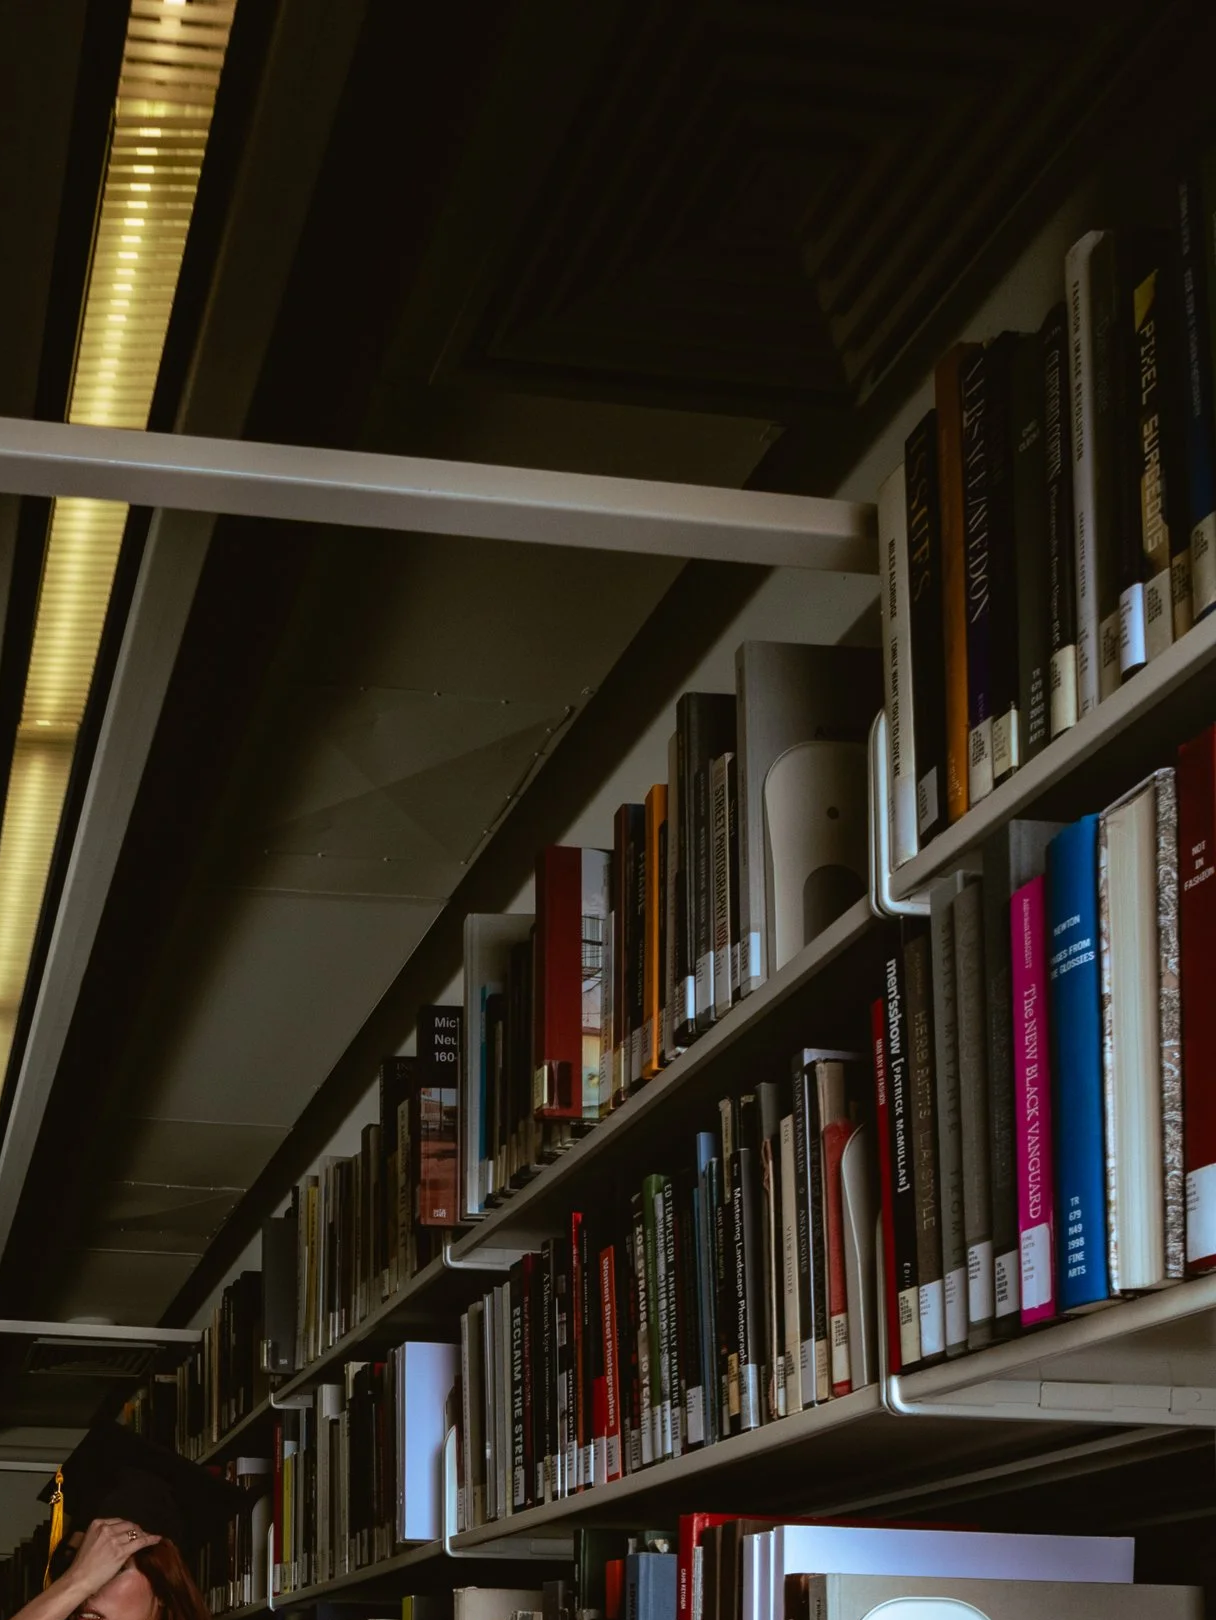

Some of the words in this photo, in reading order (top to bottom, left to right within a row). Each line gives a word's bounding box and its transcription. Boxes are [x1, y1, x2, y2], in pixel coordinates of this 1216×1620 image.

[1072, 280, 1080, 333] FASHION
[1074, 338, 1082, 376] IMAGE
[1140, 318, 1158, 406] PIXEL
[1074, 382, 1083, 462] REVOLUTION
[1142, 412, 1166, 555] SURGEONS
[909, 430, 931, 602] ISSUES
[888, 539, 896, 571] MILES
[890, 572, 898, 619] ALDRIDGE
[892, 670, 900, 697] WANT
[893, 722, 900, 734] TO
[893, 735, 901, 761] LOVE
[893, 763, 901, 777] ME
[713, 786, 728, 833] STREET
[1191, 840, 1207, 857] NOT
[1193, 857, 1205, 871] IN
[715, 834, 729, 921] PHOTOGRAPHY
[1184, 865, 1216, 892] FASHION
[1054, 914, 1081, 937] NEWTON
[1070, 938, 1092, 956] FROM
[1059, 949, 1096, 977] GLOSSIES
[885, 958, 907, 1055] men'sshow
[1023, 983, 1037, 1020] The
[914, 1008, 929, 1063] HERB
[1024, 1021, 1038, 1060] NEW
[876, 1054, 884, 1069] RAY
[794, 1070, 804, 1113] STUART
[878, 1078, 887, 1108] FASHION
[891, 1057, 906, 1116] [PATRICK
[1025, 1063, 1040, 1122] BLACK
[783, 1123, 791, 1144] FOX
[796, 1114, 806, 1174] FRANKLIN
[893, 1119, 911, 1193] McMULLAN]
[1027, 1122, 1042, 1220] VANGUARD
[664, 1183, 674, 1197] ED
[921, 1167, 936, 1231] STYLE
[1069, 1196, 1080, 1207] TR
[665, 1198, 676, 1263] TEMPLETON
[733, 1186, 744, 1242] Mastering
[1068, 1208, 1082, 1221] 679
[785, 1223, 793, 1253] VIEW
[799, 1207, 809, 1274] ANALOGIES
[1067, 1236, 1085, 1251] 1998
[1067, 1250, 1085, 1265] FINE
[601, 1256, 611, 1302] Women
[734, 1243, 745, 1298] Landscape
[1067, 1264, 1086, 1280] ARTS
[637, 1259, 648, 1333] STRAUSS
[667, 1269, 678, 1349] TANGENTIALLY
[603, 1303, 613, 1338] Street
[736, 1299, 747, 1366] Photography
[512, 1307, 524, 1382] RECLAIM
[512, 1386, 524, 1419] THE
[605, 1339, 616, 1428] Photographers
